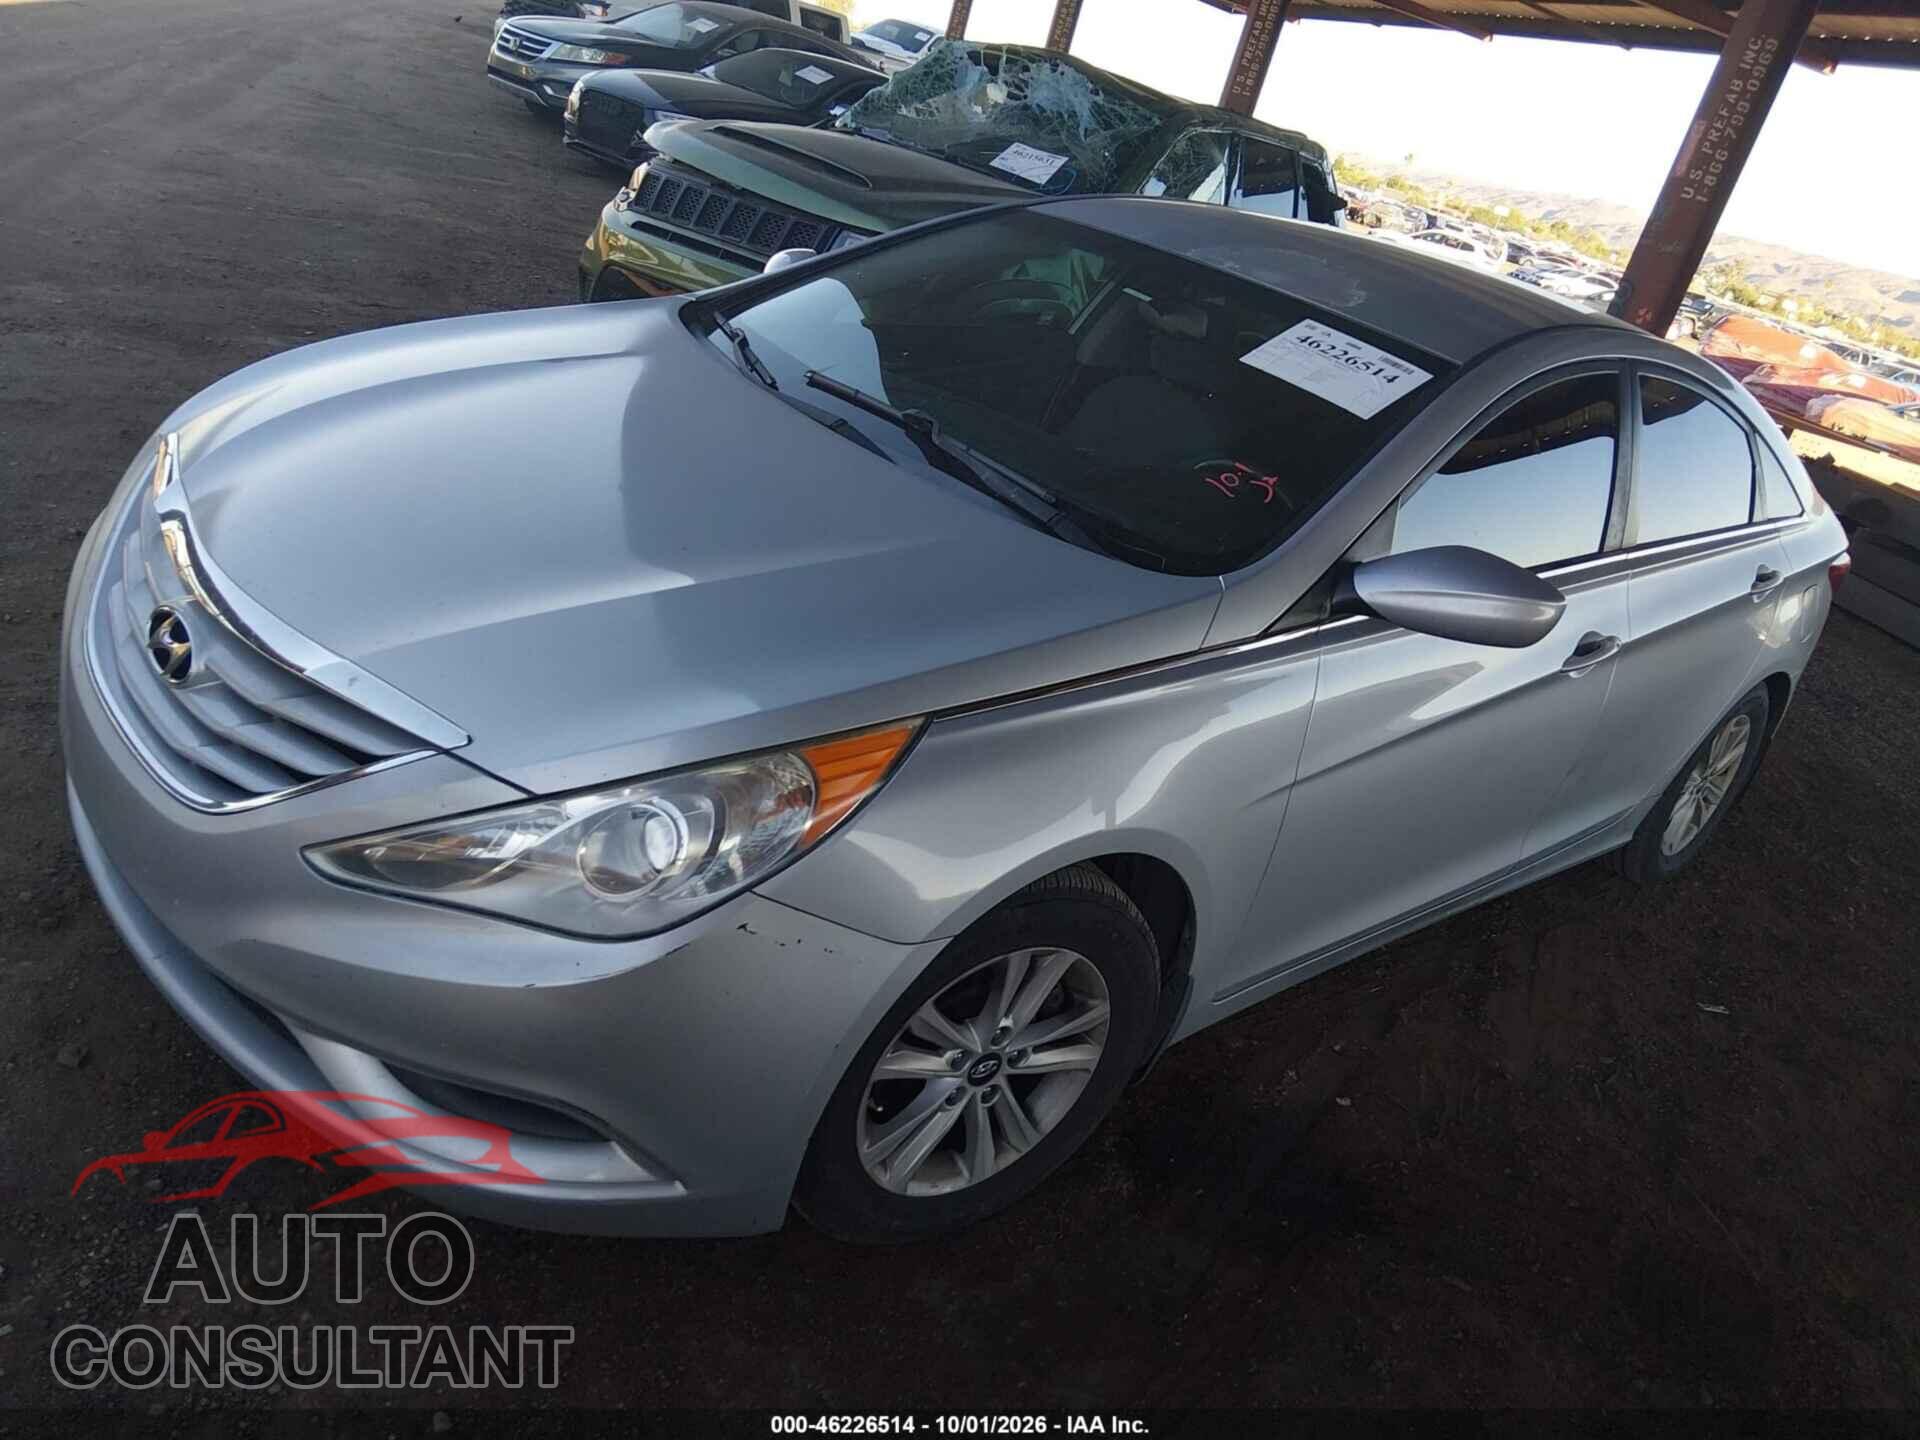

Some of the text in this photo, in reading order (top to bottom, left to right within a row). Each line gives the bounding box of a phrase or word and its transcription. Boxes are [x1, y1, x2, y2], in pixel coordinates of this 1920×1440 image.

[1241, 20, 1263, 67] PREFAB
[1680, 33, 1766, 199] U.S. PREFAB INC.
[1295, 334, 1401, 384] 46226514
